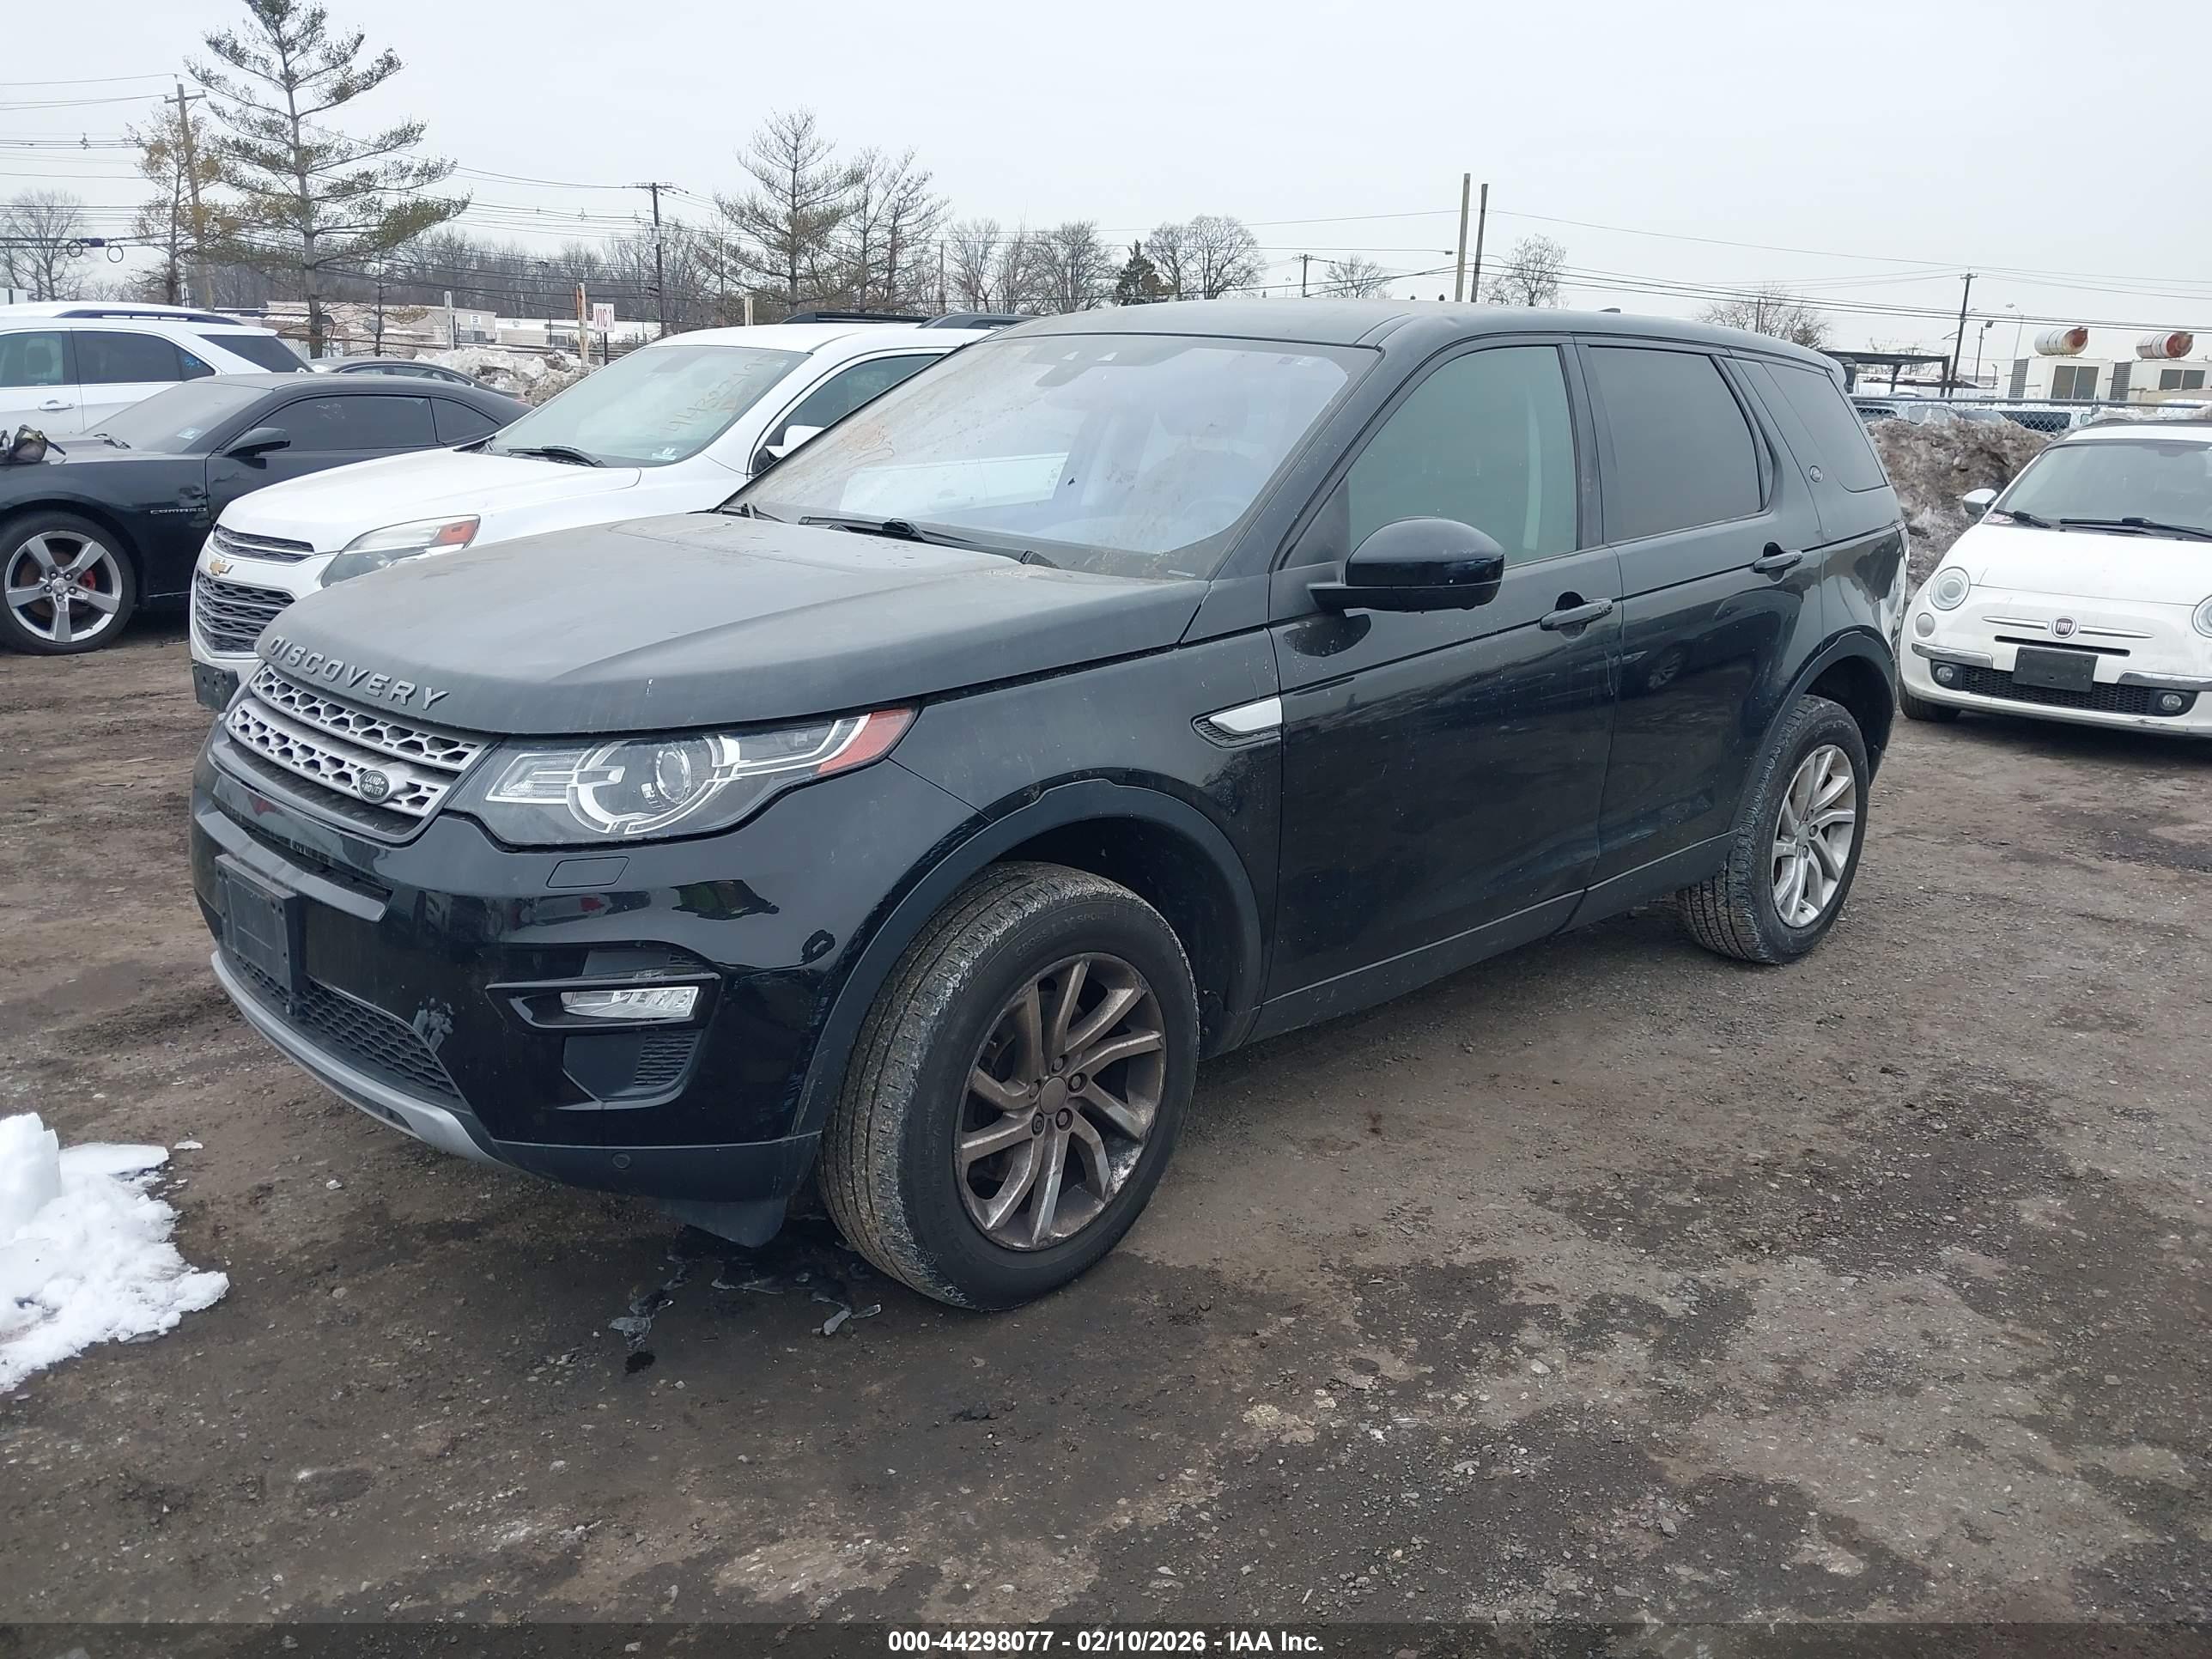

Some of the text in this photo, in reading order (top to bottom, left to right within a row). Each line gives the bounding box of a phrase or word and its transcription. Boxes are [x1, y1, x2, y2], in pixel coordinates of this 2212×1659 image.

[595, 308, 607, 327] VIC
[2057, 622, 2072, 633] FIAT
[270, 635, 449, 710] DISCOVERY
[364, 775, 382, 786] LAND
[363, 782, 384, 796] ROVER
